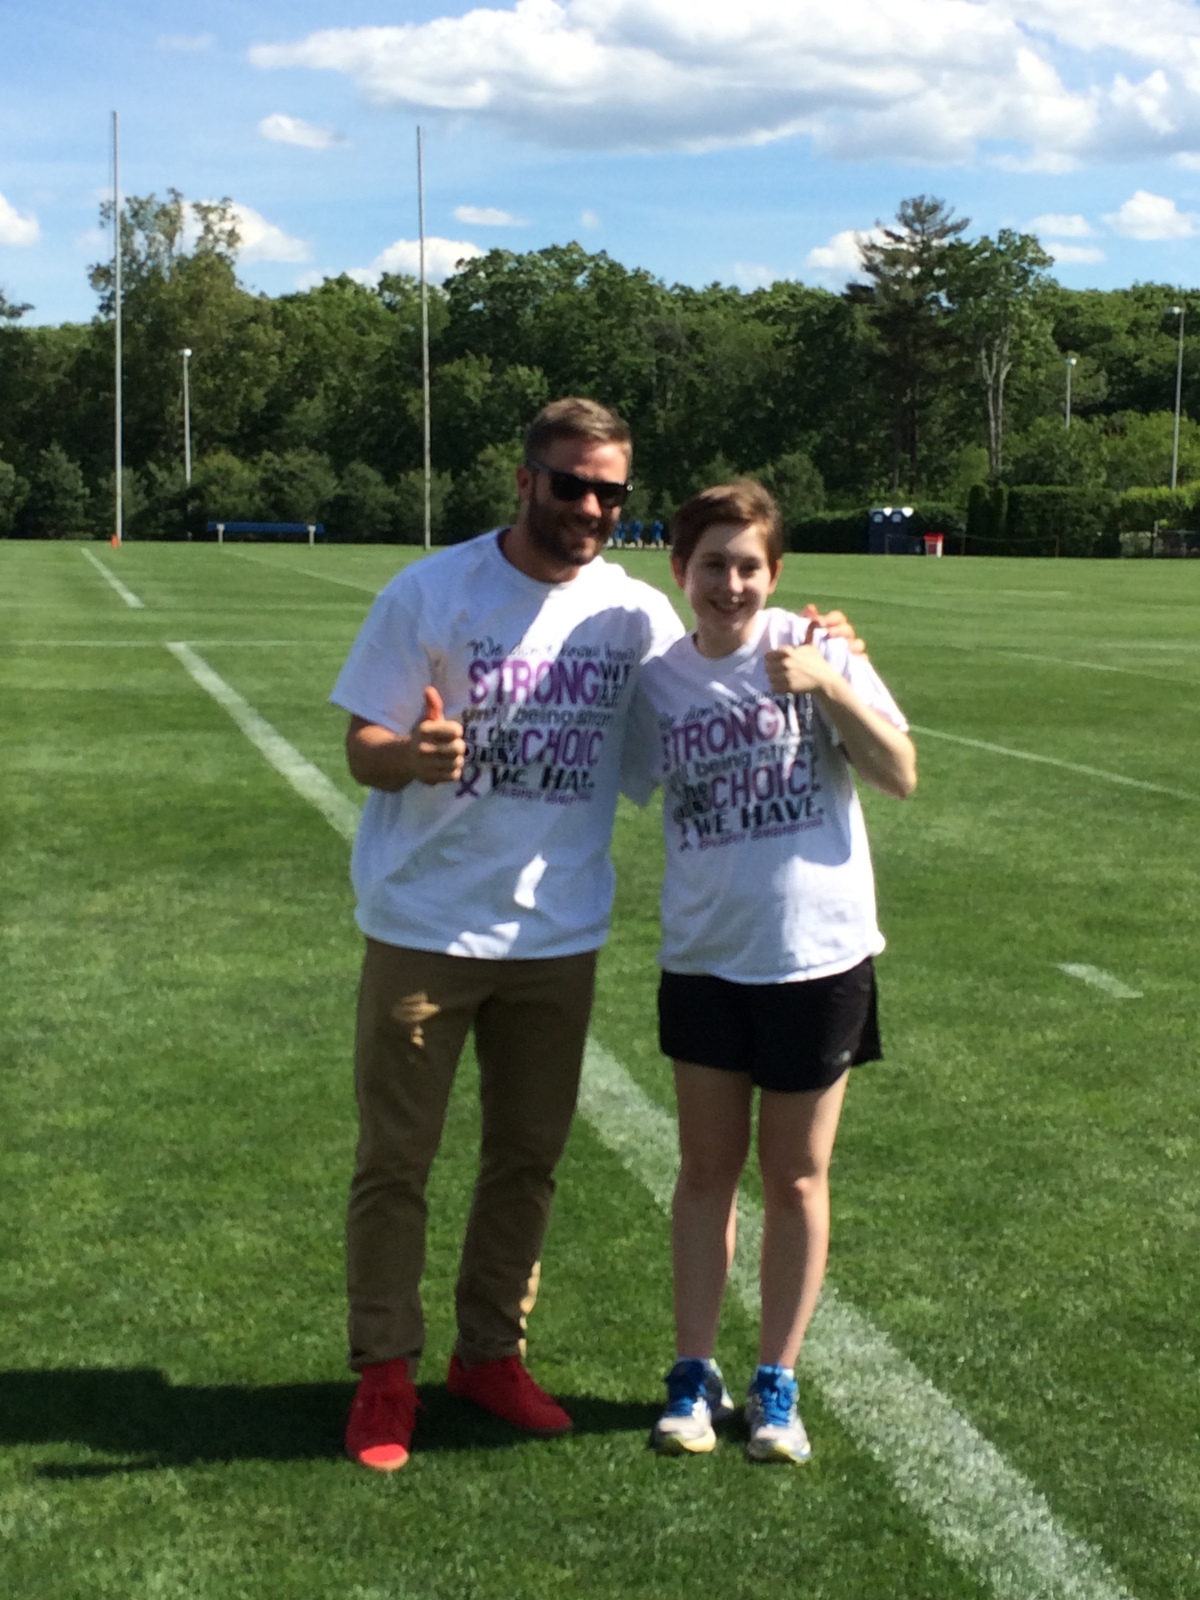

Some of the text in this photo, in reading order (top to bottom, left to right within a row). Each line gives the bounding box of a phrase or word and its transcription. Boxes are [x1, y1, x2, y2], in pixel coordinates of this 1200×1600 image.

[469, 659, 599, 705] STRONG
[520, 728, 603, 767] CHOIC
[694, 814, 730, 839] WE
